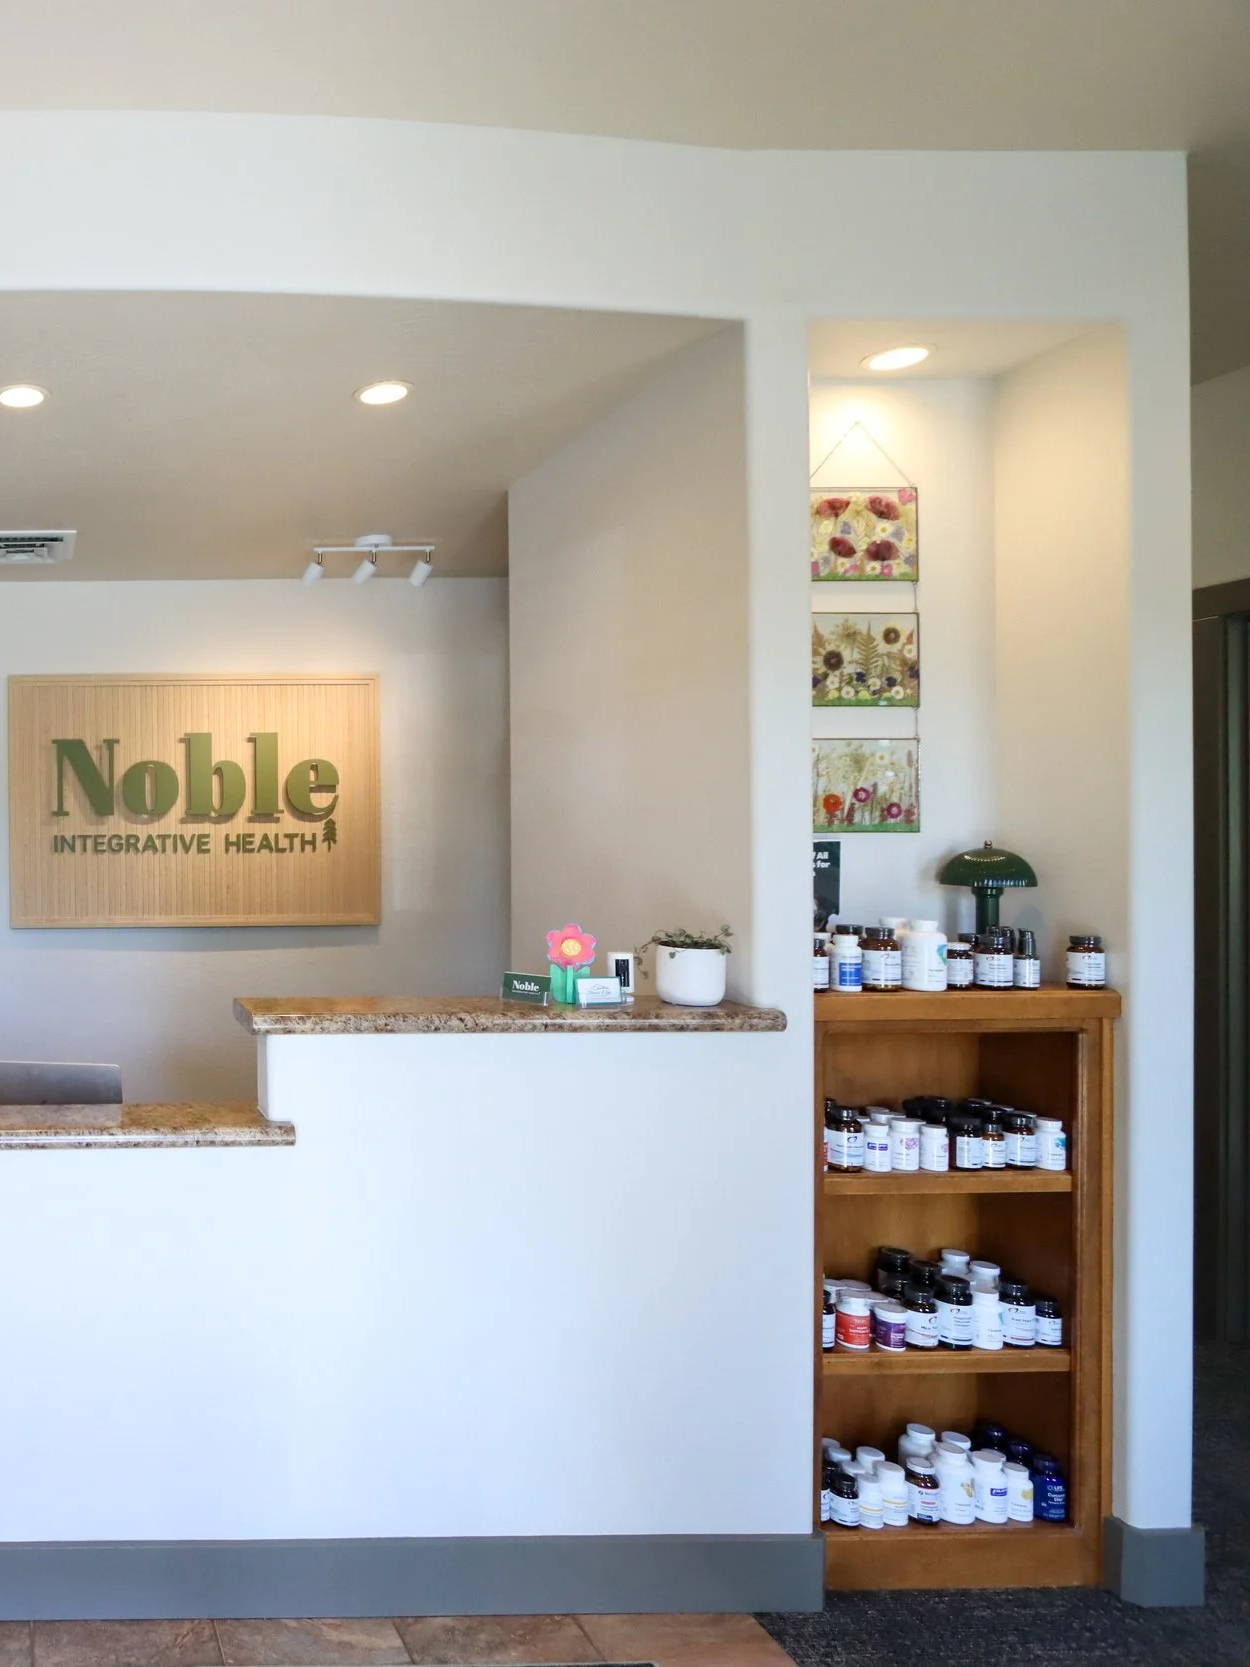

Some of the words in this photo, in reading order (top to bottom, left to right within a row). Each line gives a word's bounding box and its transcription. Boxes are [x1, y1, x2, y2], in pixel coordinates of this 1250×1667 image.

[51, 732, 340, 818] Noble
[53, 833, 211, 854] INTEGRATIVE
[224, 832, 317, 854] HEALTH
[512, 980, 540, 992] Noble
